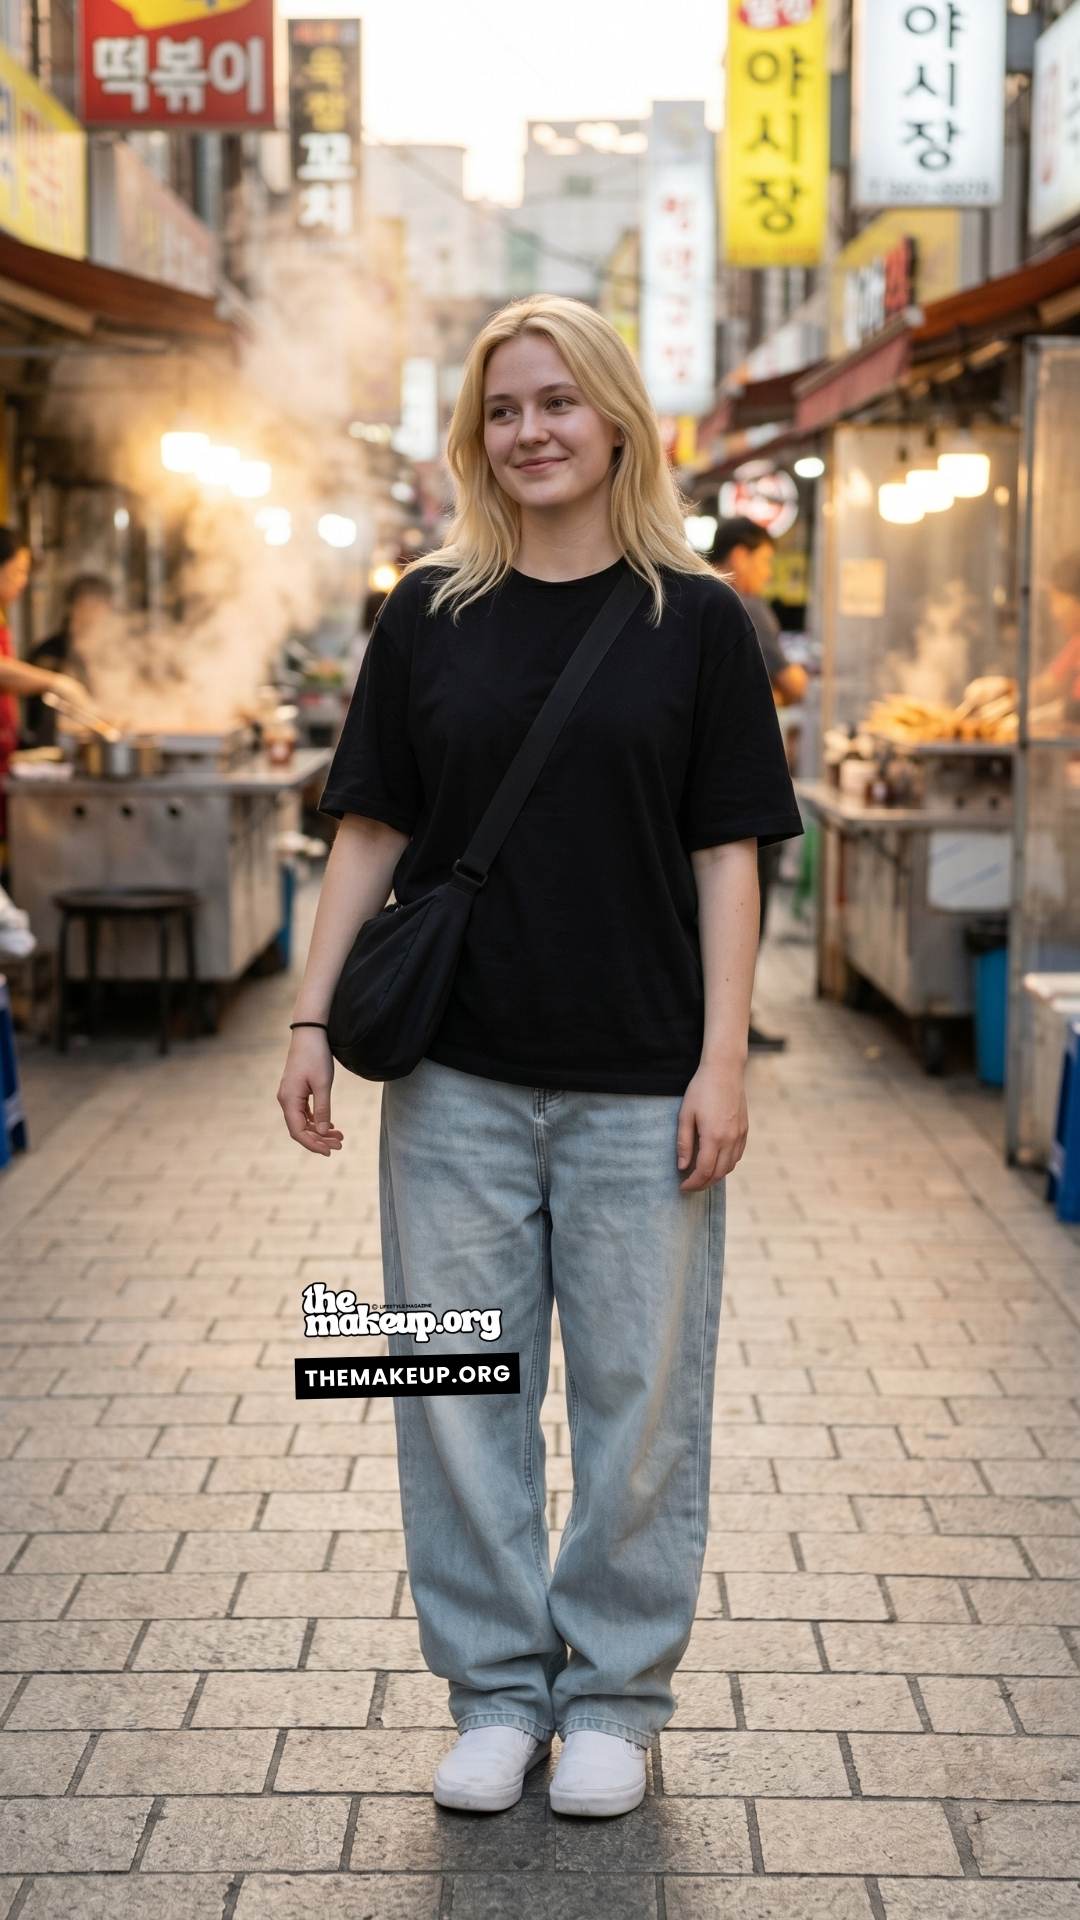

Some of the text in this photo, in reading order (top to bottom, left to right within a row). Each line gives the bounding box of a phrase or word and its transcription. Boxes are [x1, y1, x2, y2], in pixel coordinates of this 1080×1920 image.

[92, 35, 266, 114] 떡볶이
[746, 47, 812, 234] 야시장
[903, 3, 967, 171] 야시장
